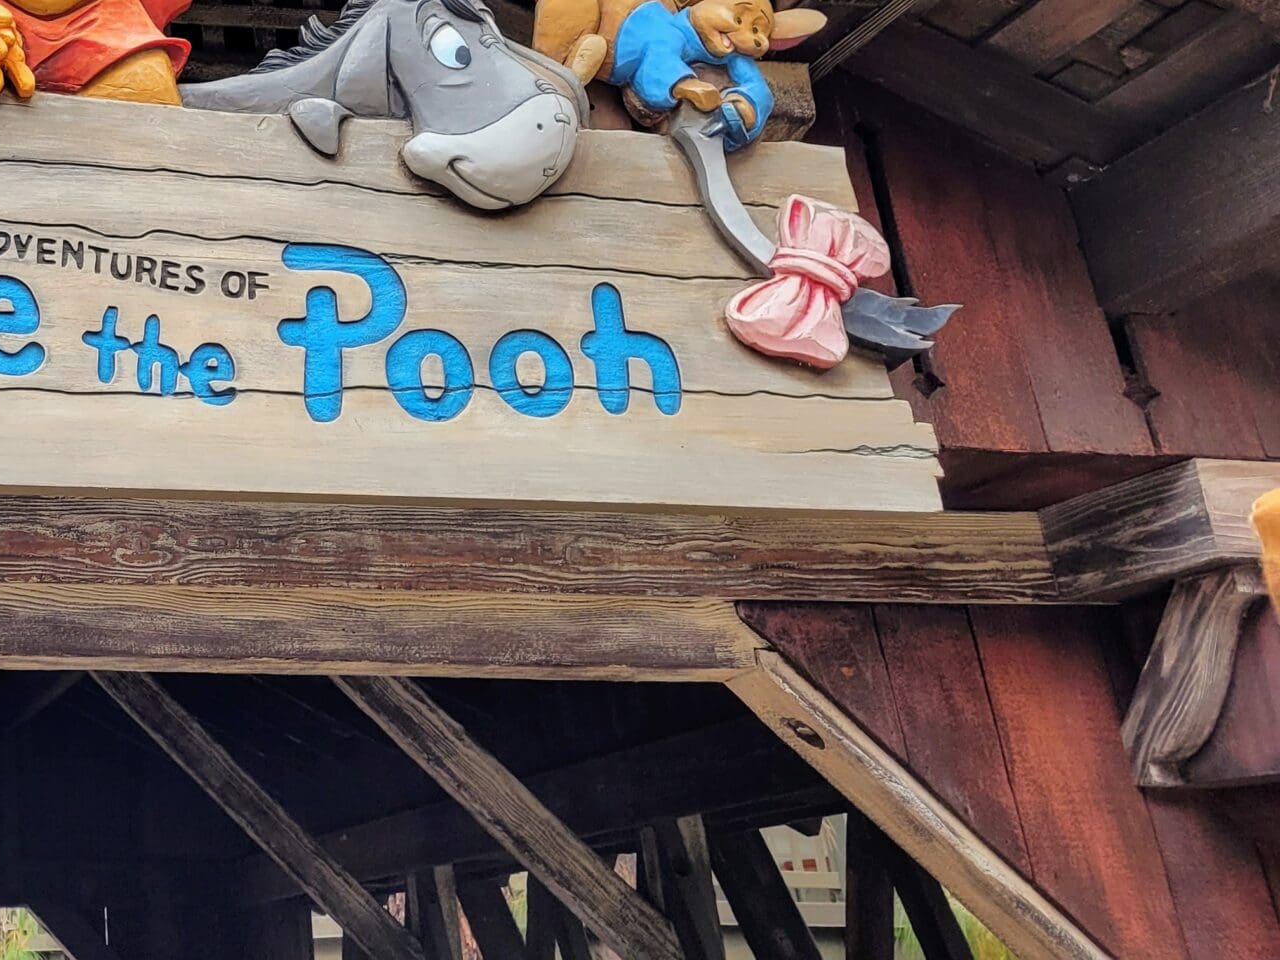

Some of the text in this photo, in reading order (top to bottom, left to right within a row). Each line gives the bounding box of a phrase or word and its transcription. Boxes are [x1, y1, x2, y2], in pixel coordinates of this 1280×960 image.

[81, 305, 236, 405] the
[277, 242, 682, 422] Pooh
[220, 270, 270, 300] OF
